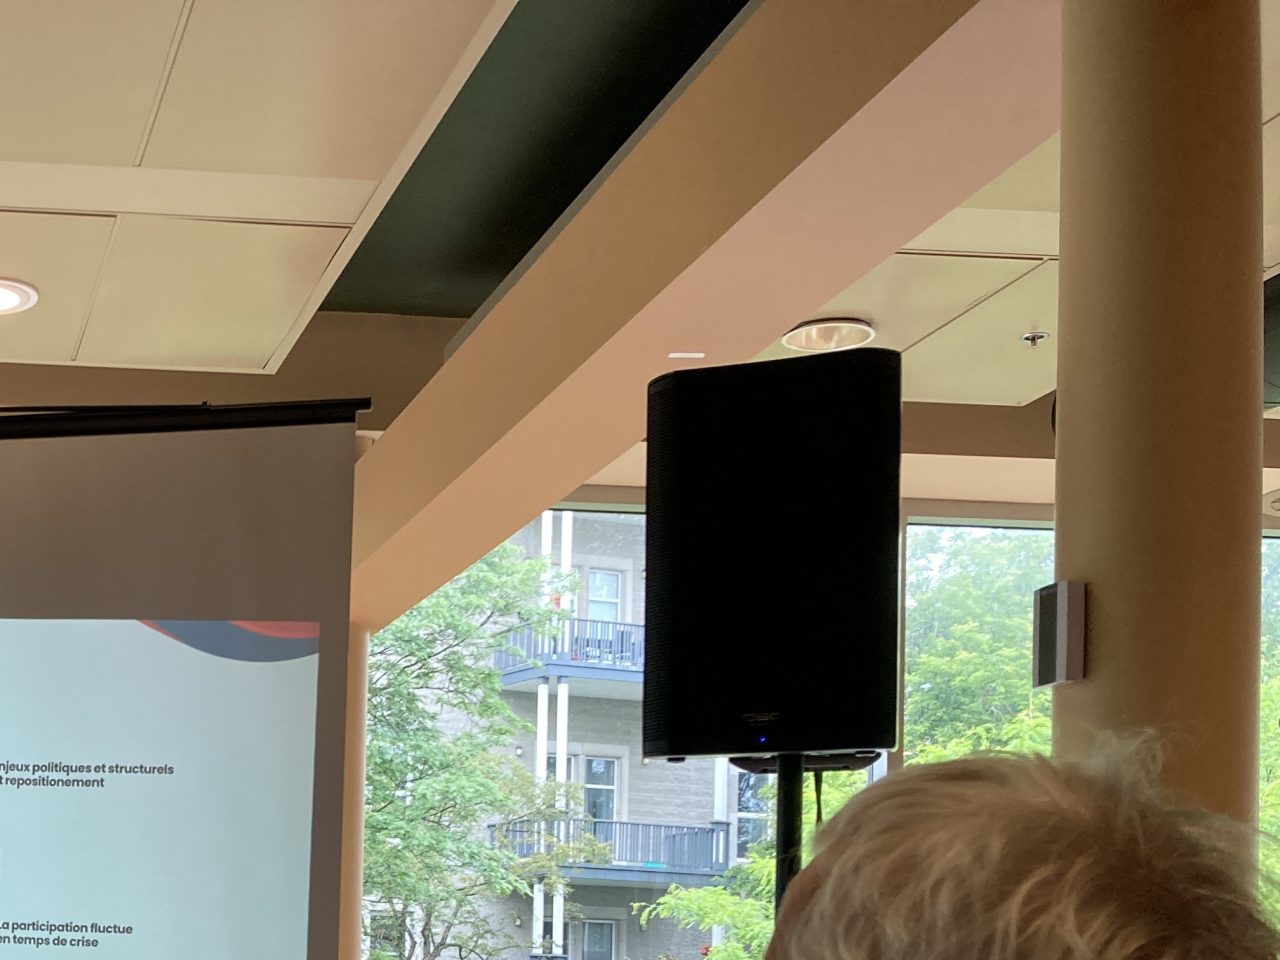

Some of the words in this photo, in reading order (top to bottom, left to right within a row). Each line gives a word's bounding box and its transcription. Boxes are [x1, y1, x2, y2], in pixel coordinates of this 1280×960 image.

[32, 762, 91, 776] politiques
[94, 764, 106, 773] et
[108, 764, 174, 774] structurels
[5, 776, 104, 788] repositionement
[12, 921, 88, 934] participation
[90, 923, 133, 934] fluctue
[13, 935, 50, 948] temps
[53, 936, 67, 945] de
[69, 937, 98, 947] crise
